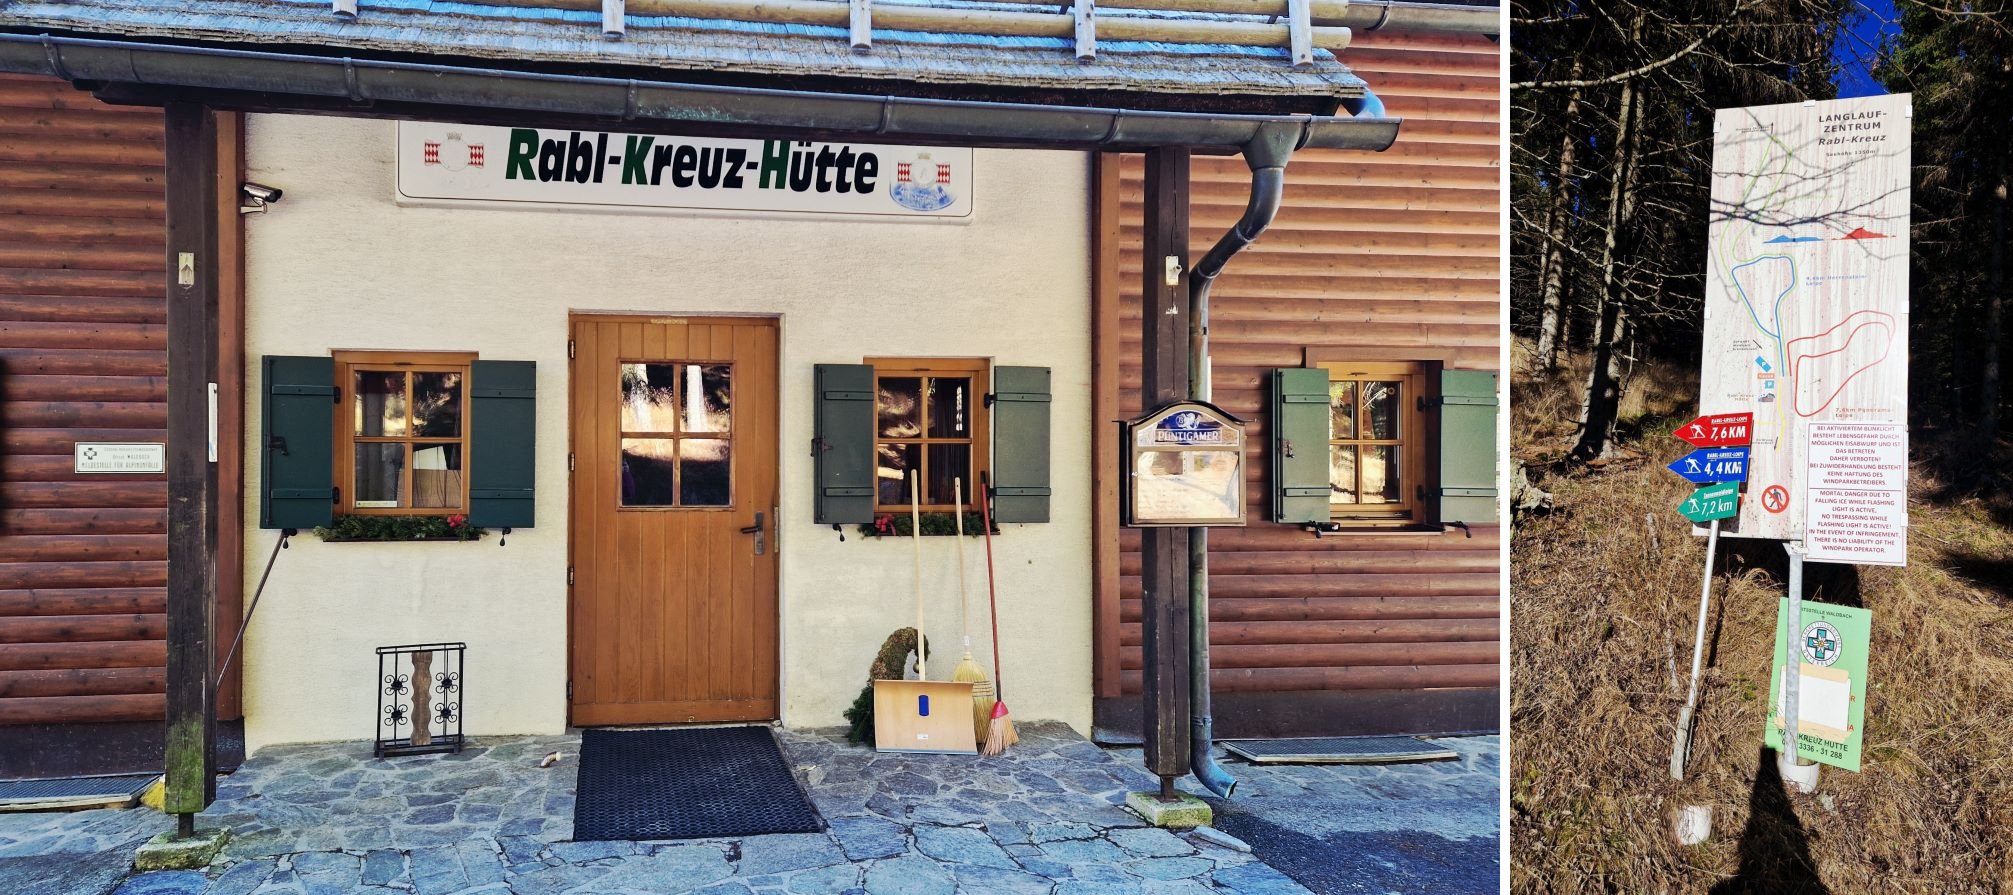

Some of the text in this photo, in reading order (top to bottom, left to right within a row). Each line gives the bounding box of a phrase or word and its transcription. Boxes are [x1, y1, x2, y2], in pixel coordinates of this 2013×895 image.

[1819, 110, 1887, 123] LANGLAUF-
[1824, 121, 1881, 133] ZENTRUM
[1818, 135, 1887, 146] Rabl-Kreuz
[506, 128, 879, 194] Rabl-Kreuz-Hütte
[1158, 431, 1219, 441] PUNTIGAMER
[1728, 426, 1746, 438] KM
[1724, 461, 1742, 474] KM
[1717, 499, 1733, 512] km
[1801, 607, 1825, 615] TSSTELLE
[1798, 733, 1823, 746] KREUZ
[1820, 748, 1828, 756] 31
[1830, 751, 1843, 760] 288
